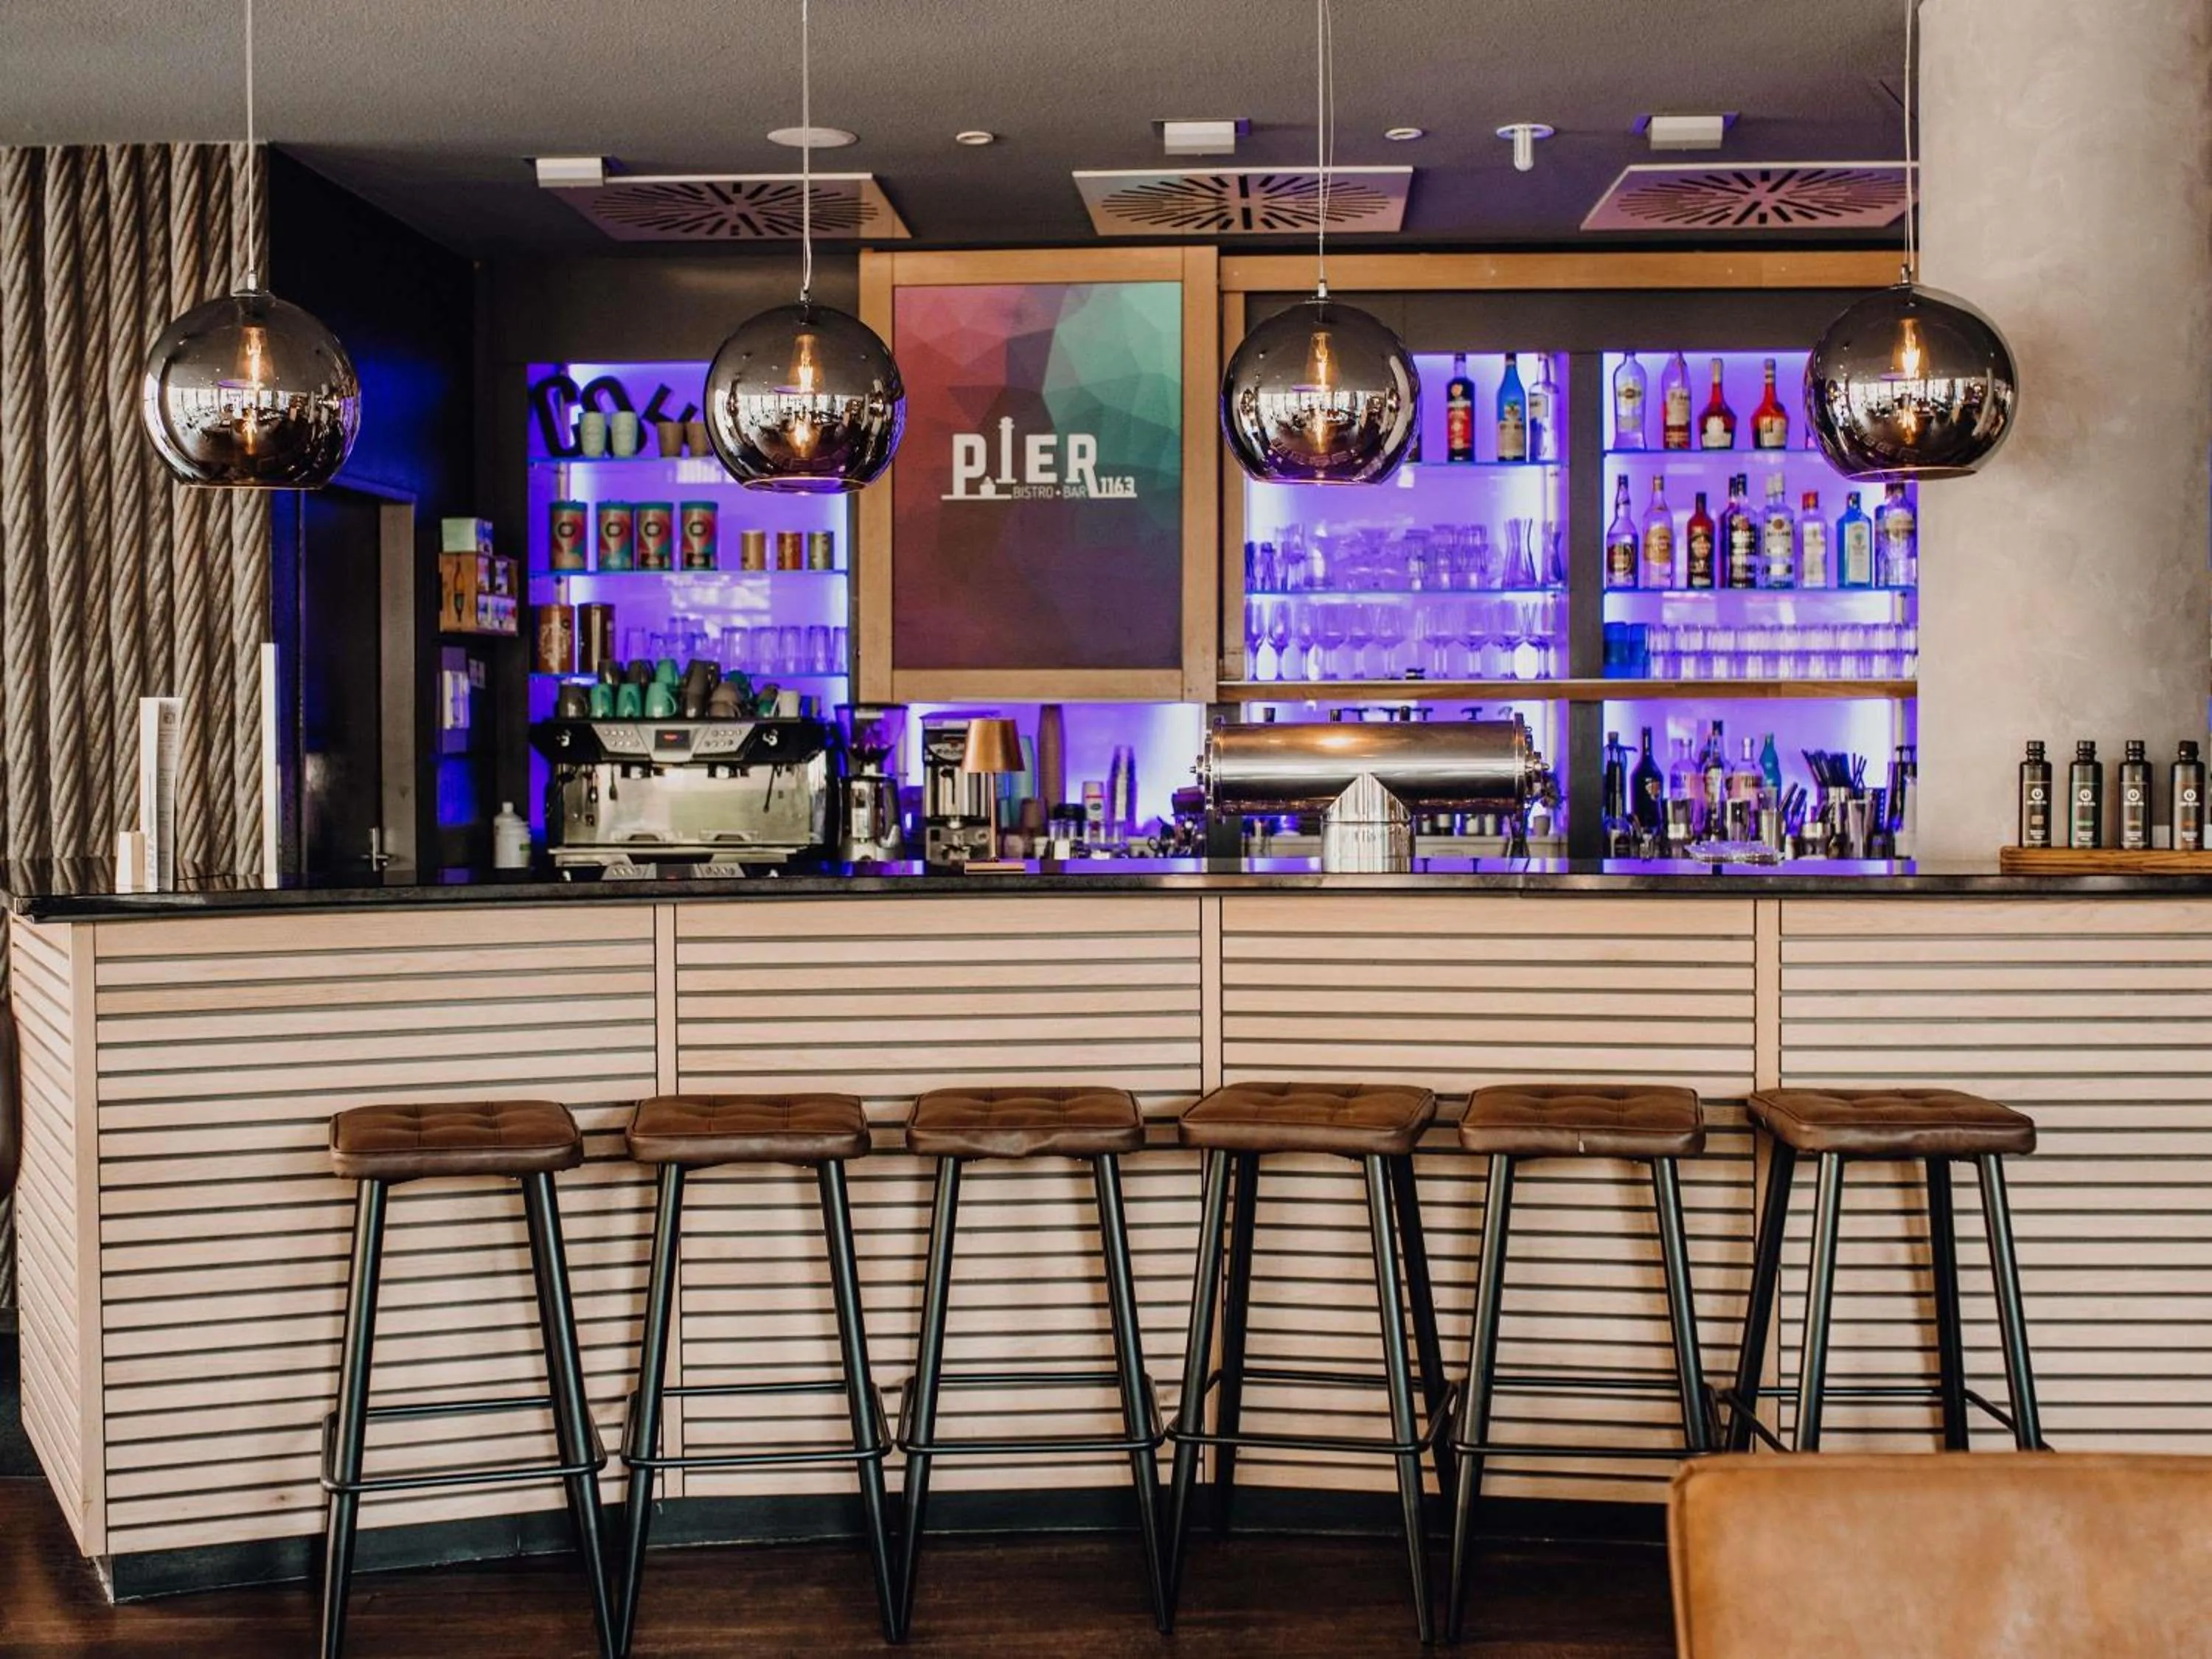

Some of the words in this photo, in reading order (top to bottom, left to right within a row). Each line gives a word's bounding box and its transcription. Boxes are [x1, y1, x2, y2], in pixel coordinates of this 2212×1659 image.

[951, 416, 1102, 500] PIER
[1099, 476, 1135, 495] 1163
[1012, 485, 1054, 499] BISTRO
[1062, 485, 1088, 499] BAR
